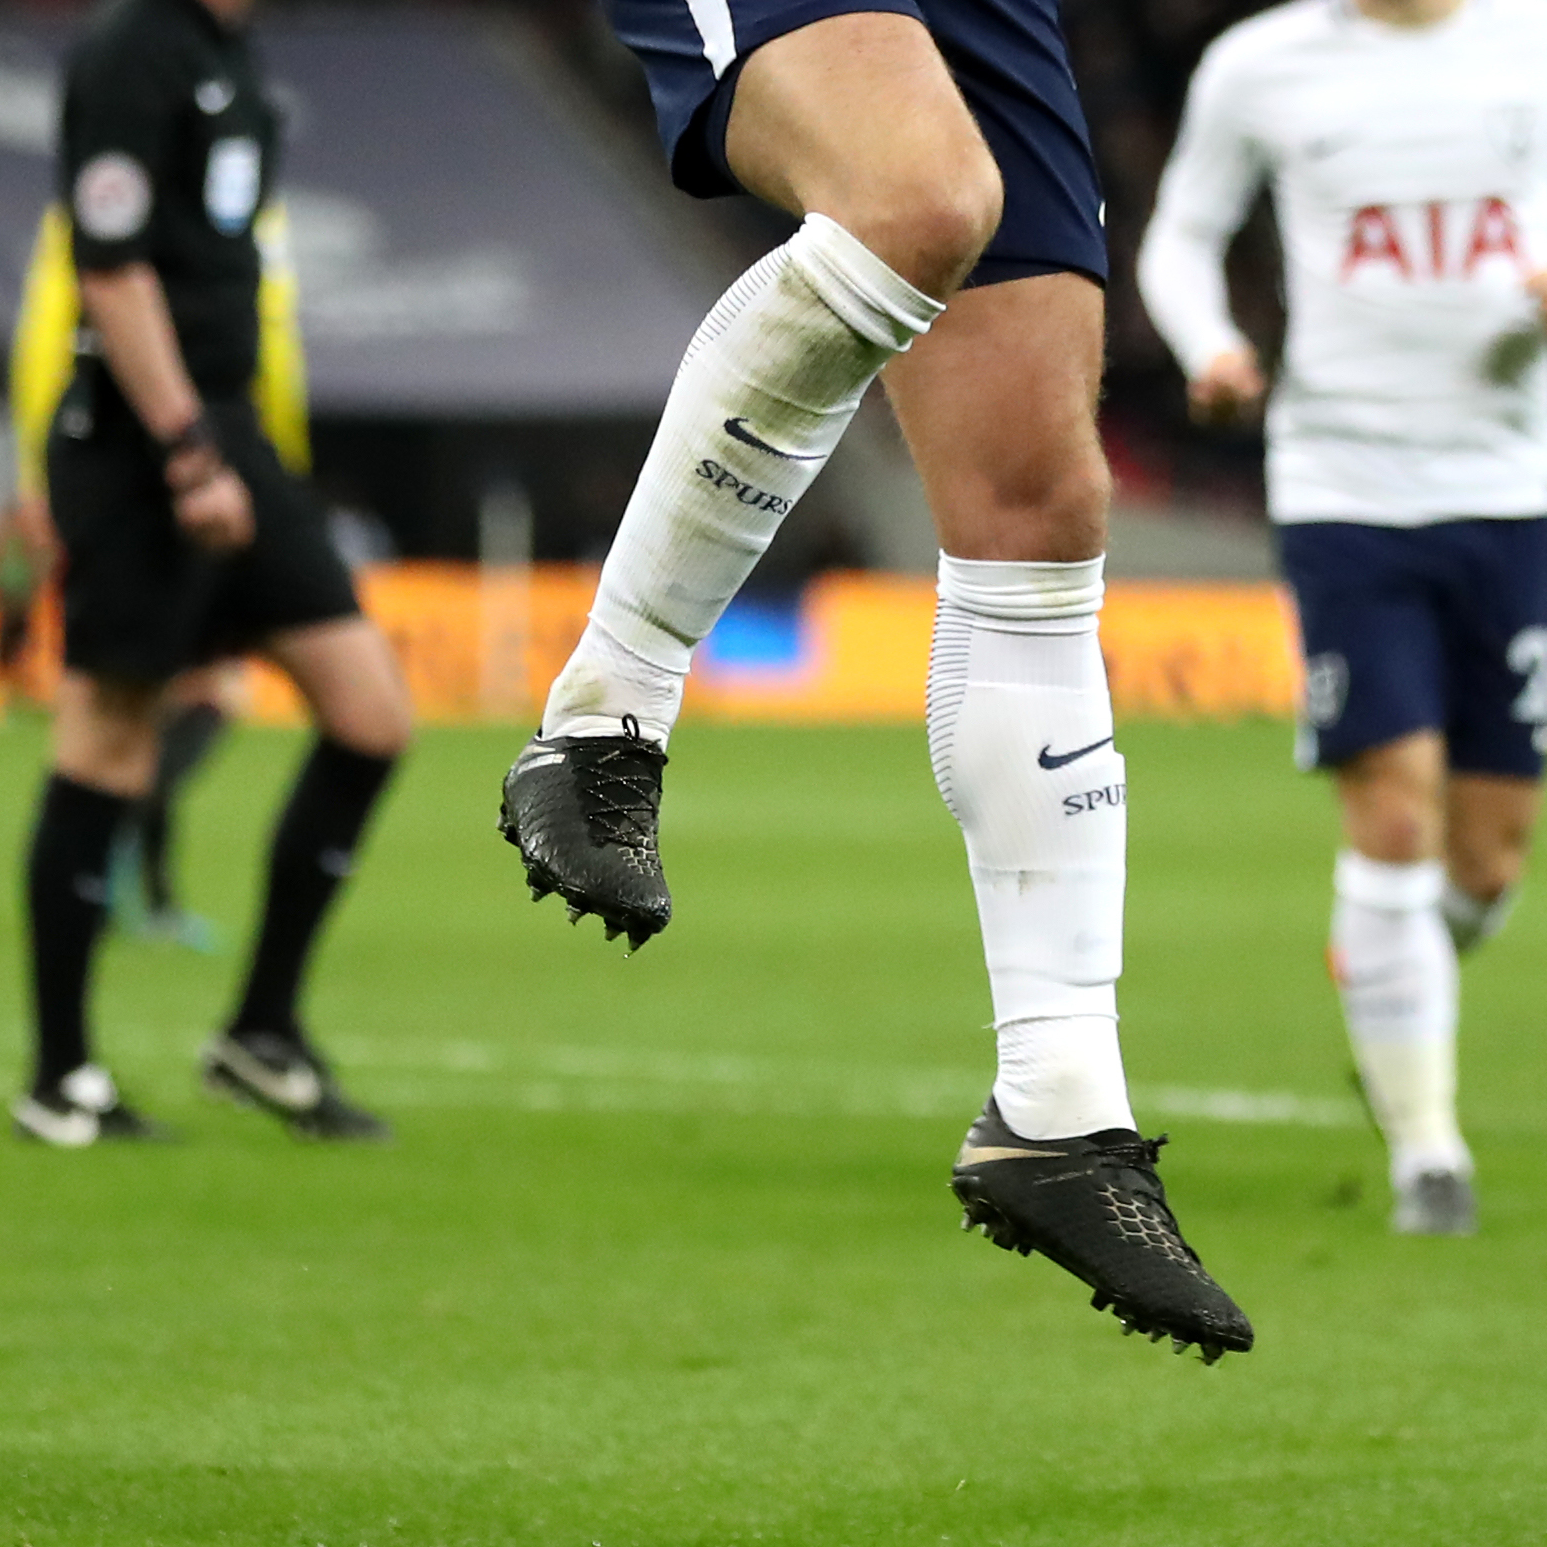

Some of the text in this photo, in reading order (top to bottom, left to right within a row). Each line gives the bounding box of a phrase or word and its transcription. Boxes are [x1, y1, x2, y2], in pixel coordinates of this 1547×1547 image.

[1338, 196, 1528, 285] AIA
[695, 458, 793, 515] SPURS
[1062, 783, 1126, 816] SPU
